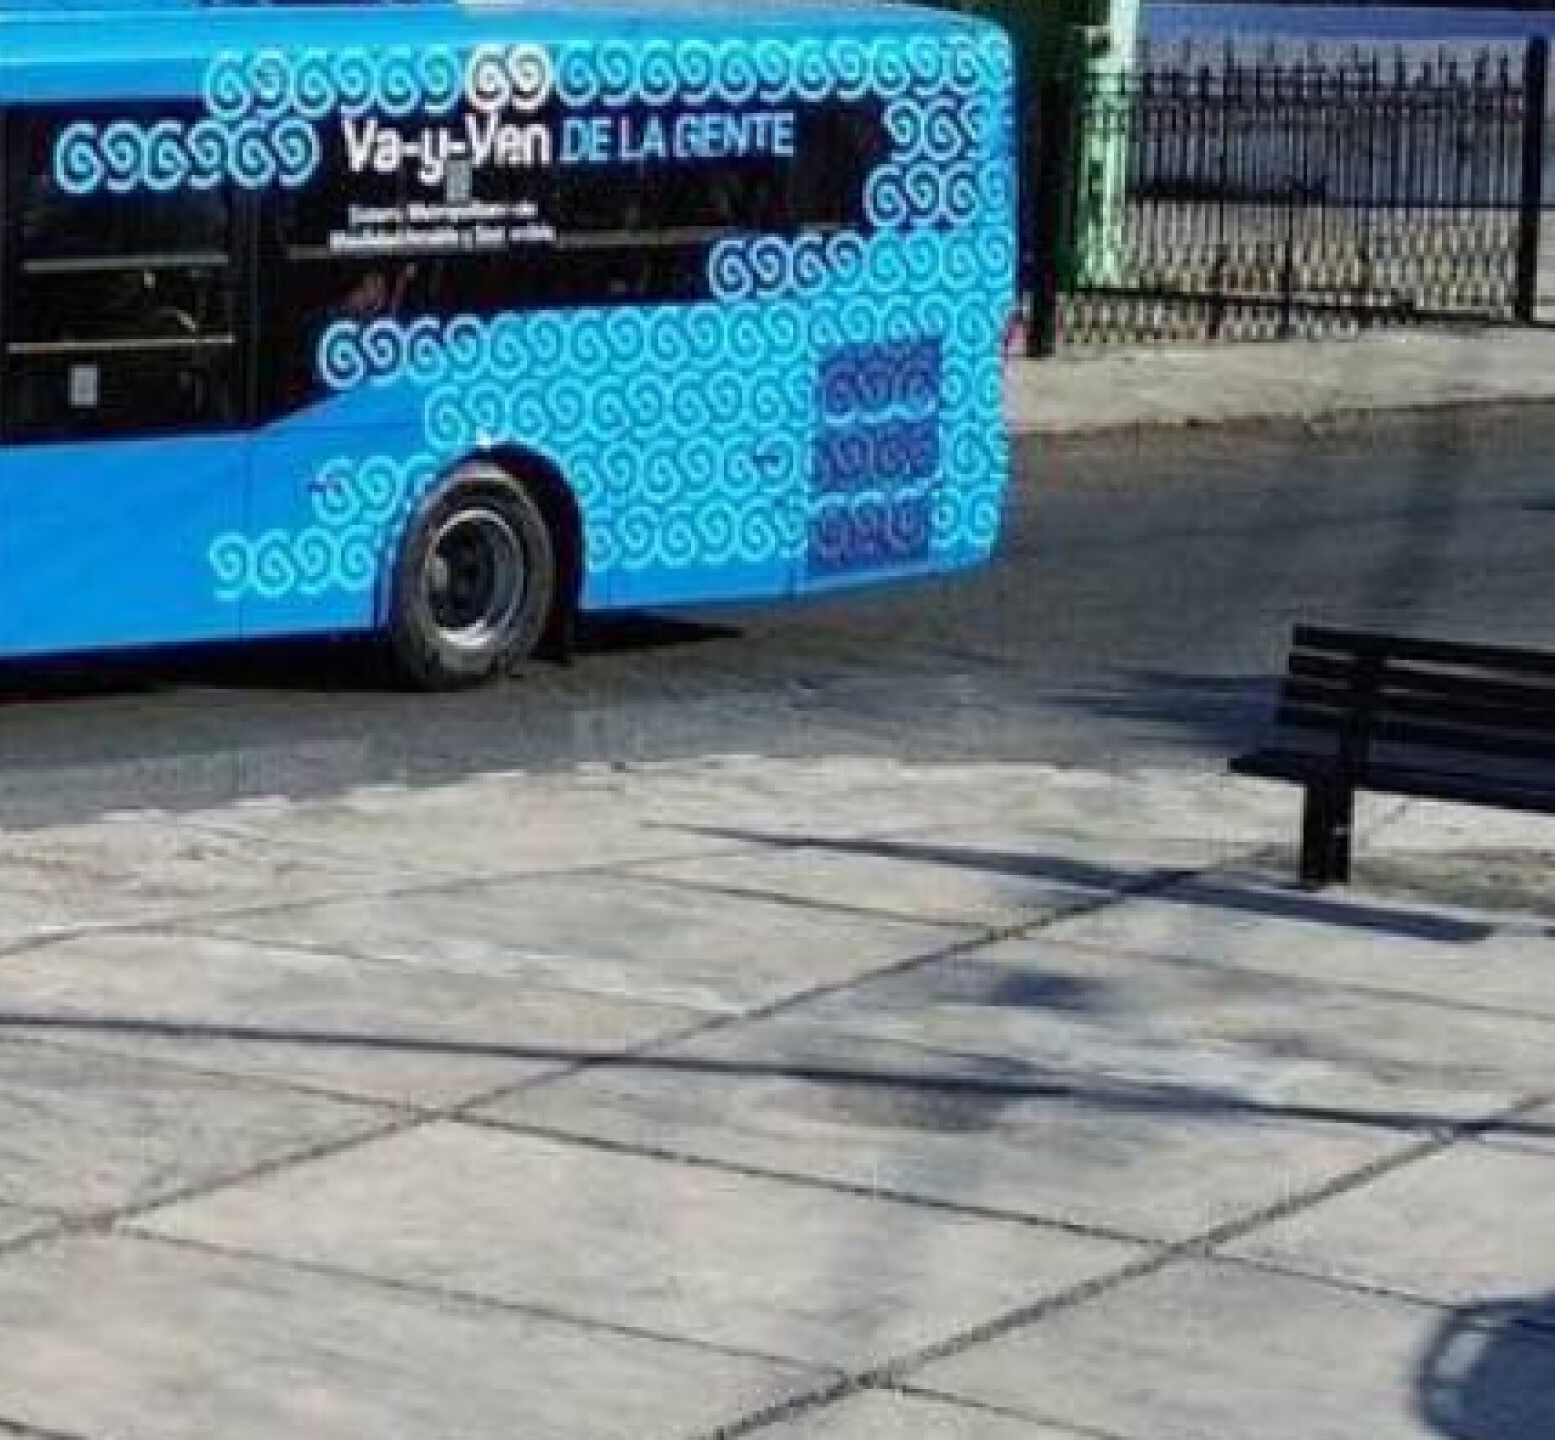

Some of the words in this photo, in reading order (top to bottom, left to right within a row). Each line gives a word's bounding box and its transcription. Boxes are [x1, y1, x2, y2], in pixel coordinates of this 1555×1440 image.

[342, 110, 552, 185] Va-y-Ven
[560, 115, 611, 162] DE
[619, 113, 666, 158] LA
[673, 111, 794, 158] GENTE
